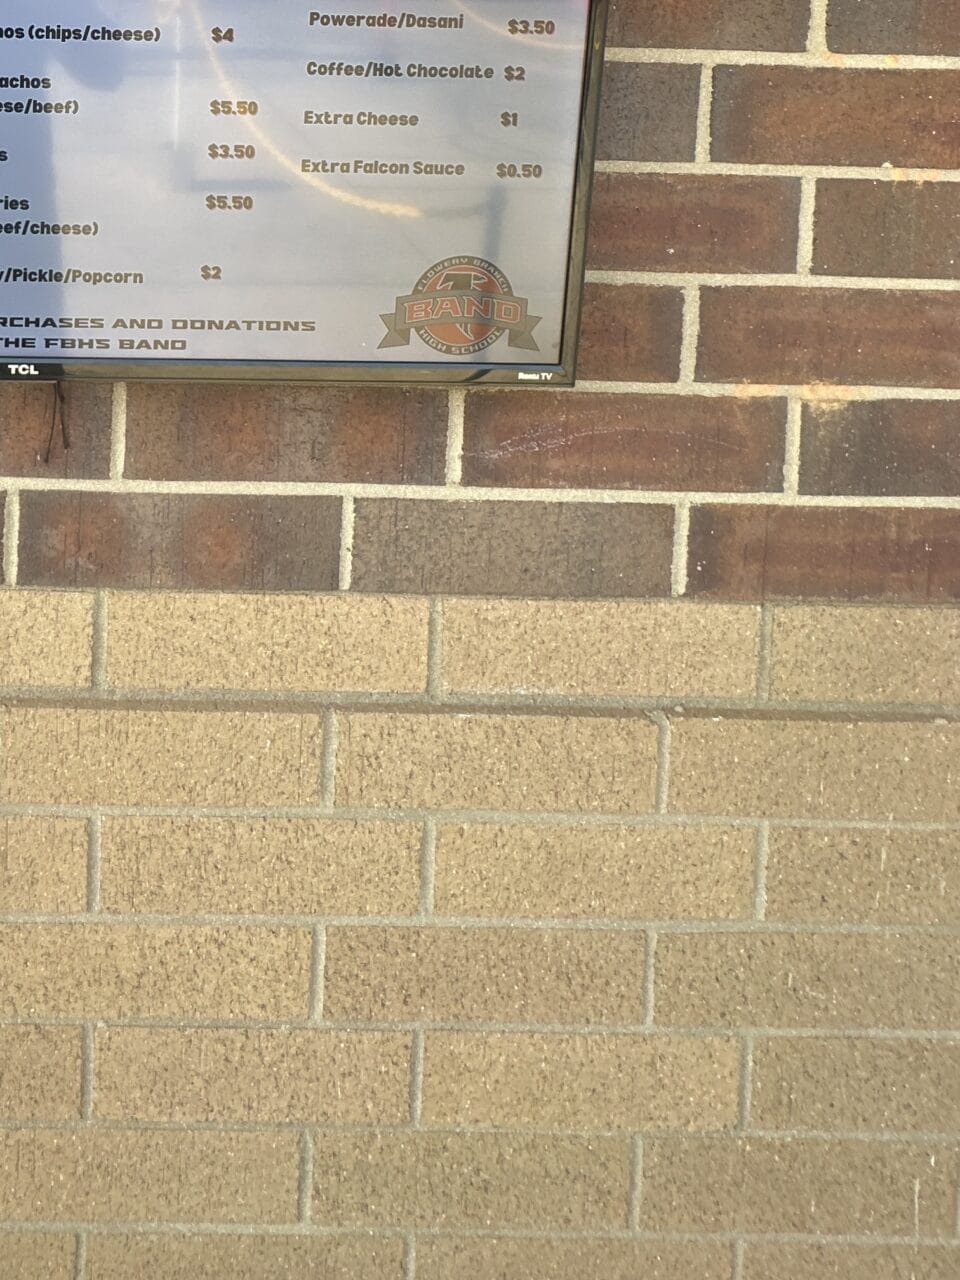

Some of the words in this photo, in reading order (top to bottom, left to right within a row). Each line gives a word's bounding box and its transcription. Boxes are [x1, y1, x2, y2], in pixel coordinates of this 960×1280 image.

[310, 12, 464, 28] Powerade/Dasani
[507, 19, 555, 34] $3.50
[28, 25, 161, 42] (chips/cheese)
[211, 27, 234, 42] $4
[307, 62, 403, 77] Coffee/Hot
[406, 64, 494, 78] Chocolate
[504, 65, 525, 81] $2
[209, 100, 258, 115] $5.50
[304, 111, 353, 124] Extra
[356, 112, 419, 126] Cheese
[500, 112, 518, 127] $1
[208, 144, 255, 159] $3.50
[301, 159, 350, 173] Extra
[353, 160, 410, 174] Falcon
[413, 161, 465, 175] Sauce
[496, 163, 542, 178] $0.50
[205, 195, 253, 210] $5.50
[200, 265, 222, 280] $2
[417, 257, 469, 291] FLOWERY
[473, 258, 510, 293] BRANCH
[403, 295, 521, 324] BAND
[111, 319, 163, 329] AND
[171, 320, 316, 331] DONATIONS
[44, 338, 111, 349] FBHS
[118, 339, 187, 351] BAND
[418, 329, 447, 352] HIGH
[451, 329, 504, 355] SCHOOL
[7, 364, 39, 375] TCL
